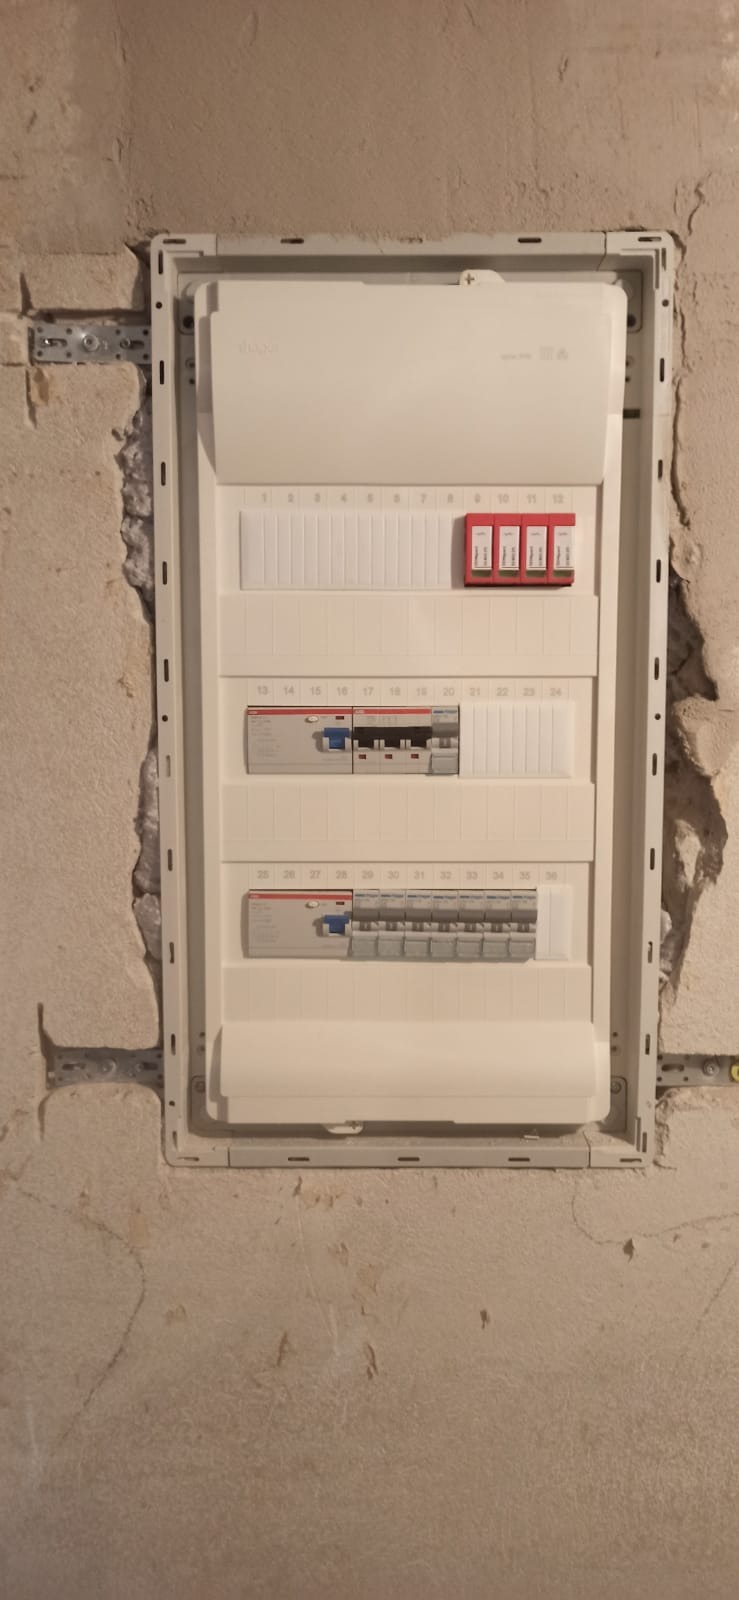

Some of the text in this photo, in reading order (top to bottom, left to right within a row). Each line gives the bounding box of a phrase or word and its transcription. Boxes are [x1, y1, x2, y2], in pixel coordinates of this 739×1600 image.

[261, 492, 267, 503] 1
[288, 493, 294, 503] 2
[341, 493, 347, 503] 4
[420, 493, 427, 504] 7
[498, 493, 509, 504] 10
[527, 493, 536, 504] 11
[257, 685, 269, 696] 13
[283, 685, 294, 696] 14
[310, 686, 321, 696] 15
[337, 686, 348, 696] 16
[363, 687, 374, 696] 17
[443, 687, 455, 696] 20
[469, 687, 480, 696] 21
[496, 687, 508, 696] 22
[549, 687, 562, 696] 24
[257, 870, 269, 880] 25
[309, 870, 321, 880] 27
[336, 870, 347, 880] 28
[362, 870, 374, 880] 29
[388, 871, 399, 880] 30
[414, 871, 424, 880] 31
[440, 871, 451, 880] 32
[492, 871, 504, 880] 34
[519, 871, 530, 880] 35
